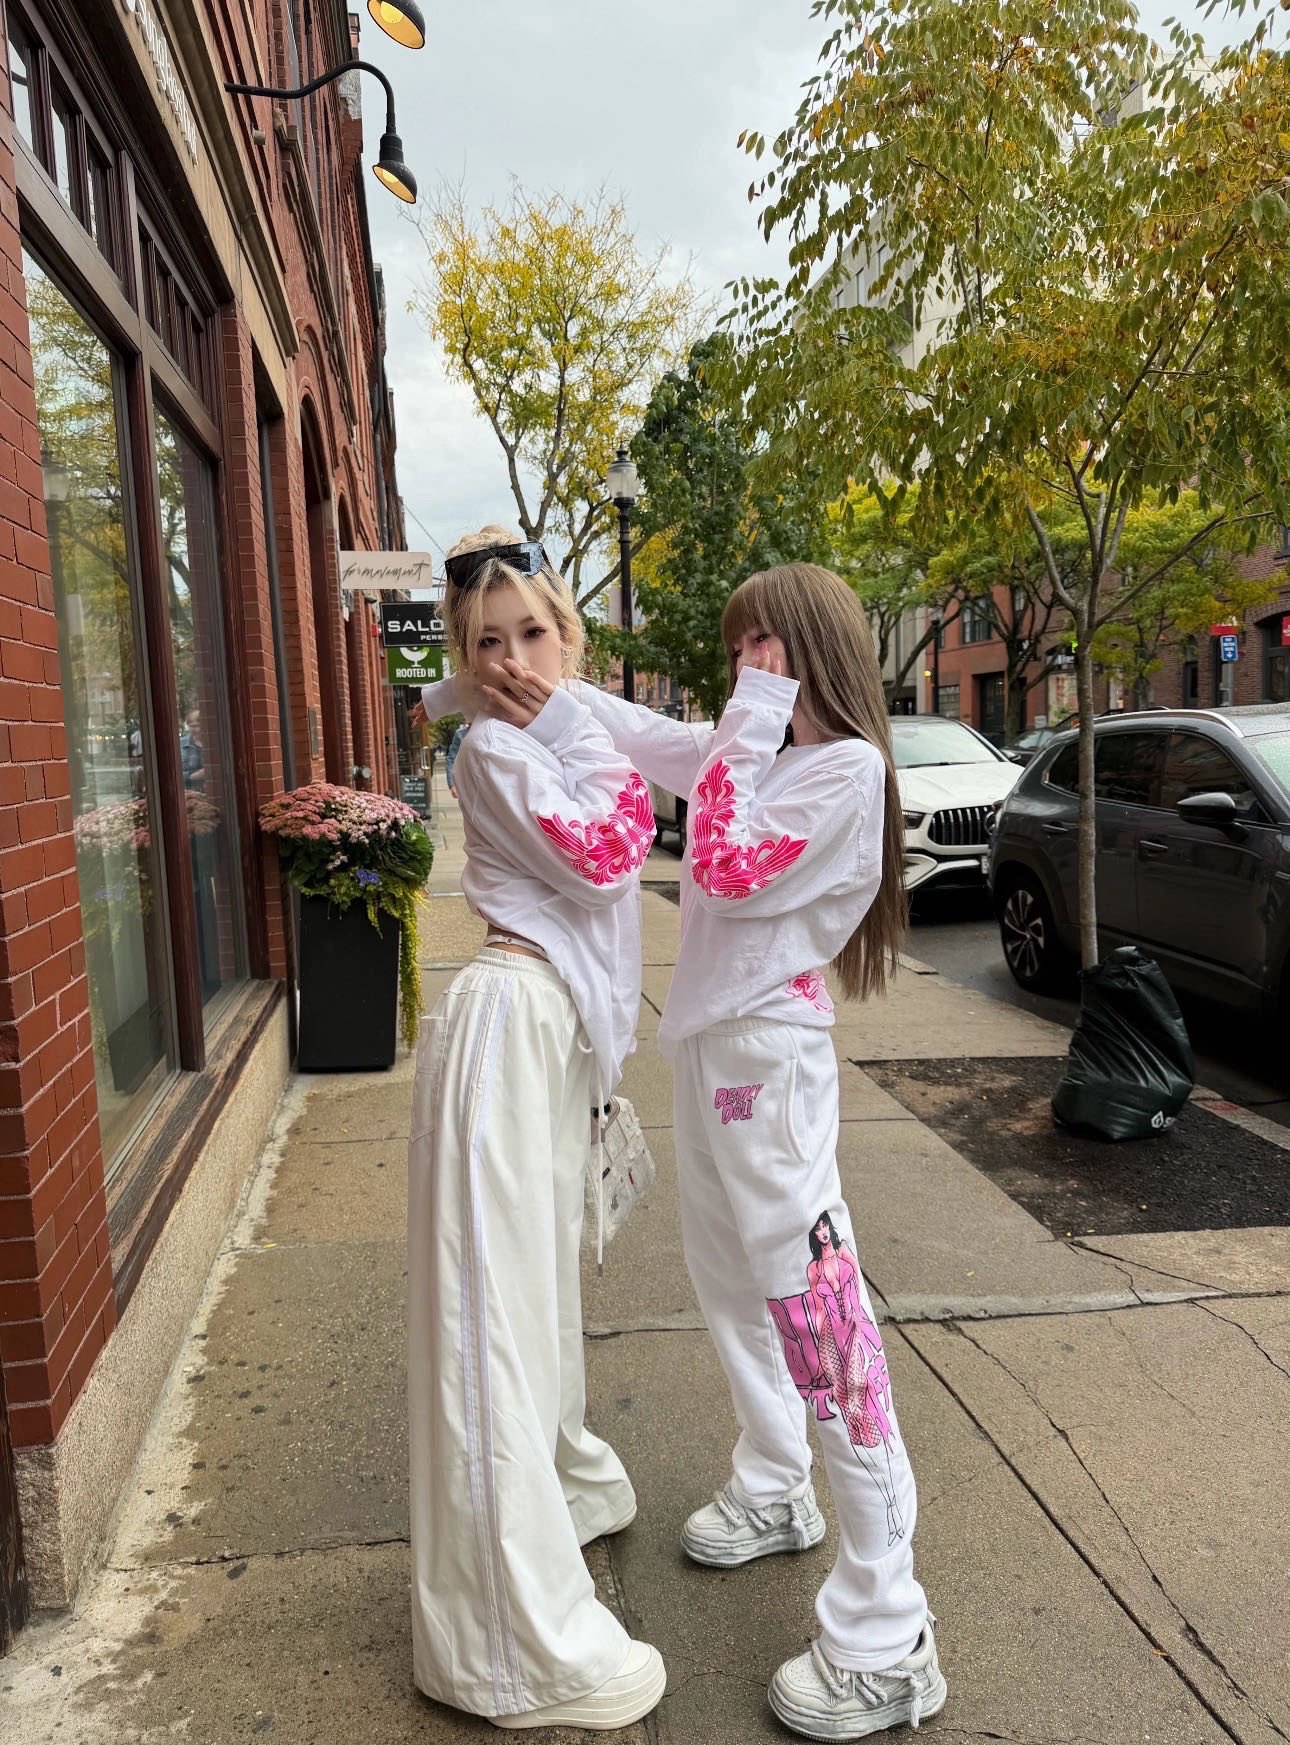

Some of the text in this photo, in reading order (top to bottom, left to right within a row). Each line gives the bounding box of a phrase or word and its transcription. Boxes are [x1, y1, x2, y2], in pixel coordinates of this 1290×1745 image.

[387, 620, 444, 632] SALO
[395, 667, 427, 679] ROOTED
[427, 667, 437, 678] IN
[722, 1099, 753, 1125] DOLL
